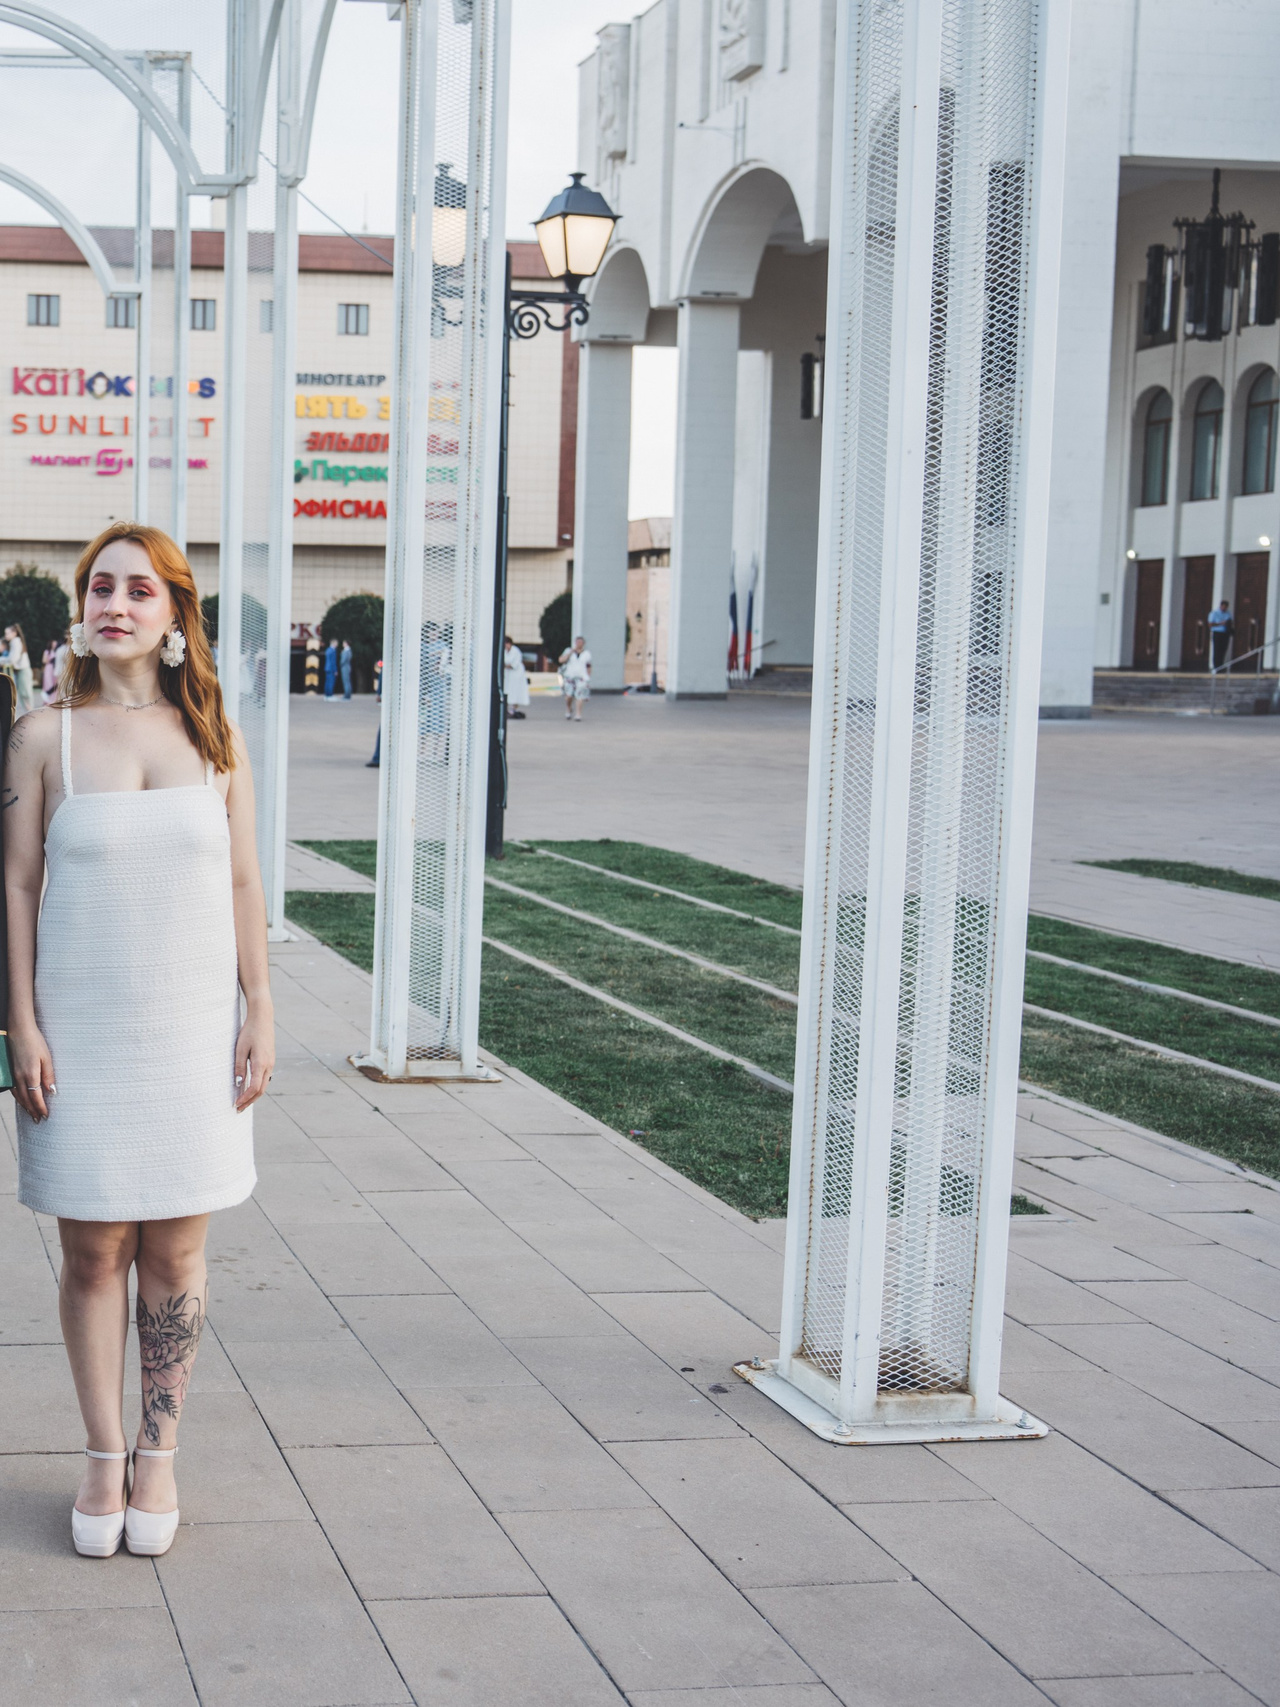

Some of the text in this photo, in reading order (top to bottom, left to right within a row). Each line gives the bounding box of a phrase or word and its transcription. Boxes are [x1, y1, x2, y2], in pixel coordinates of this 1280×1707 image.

[12, 366, 86, 397] kari
[296, 373, 386, 387] ИНОТЕАТР
[12, 413, 216, 437] SUNLIT
